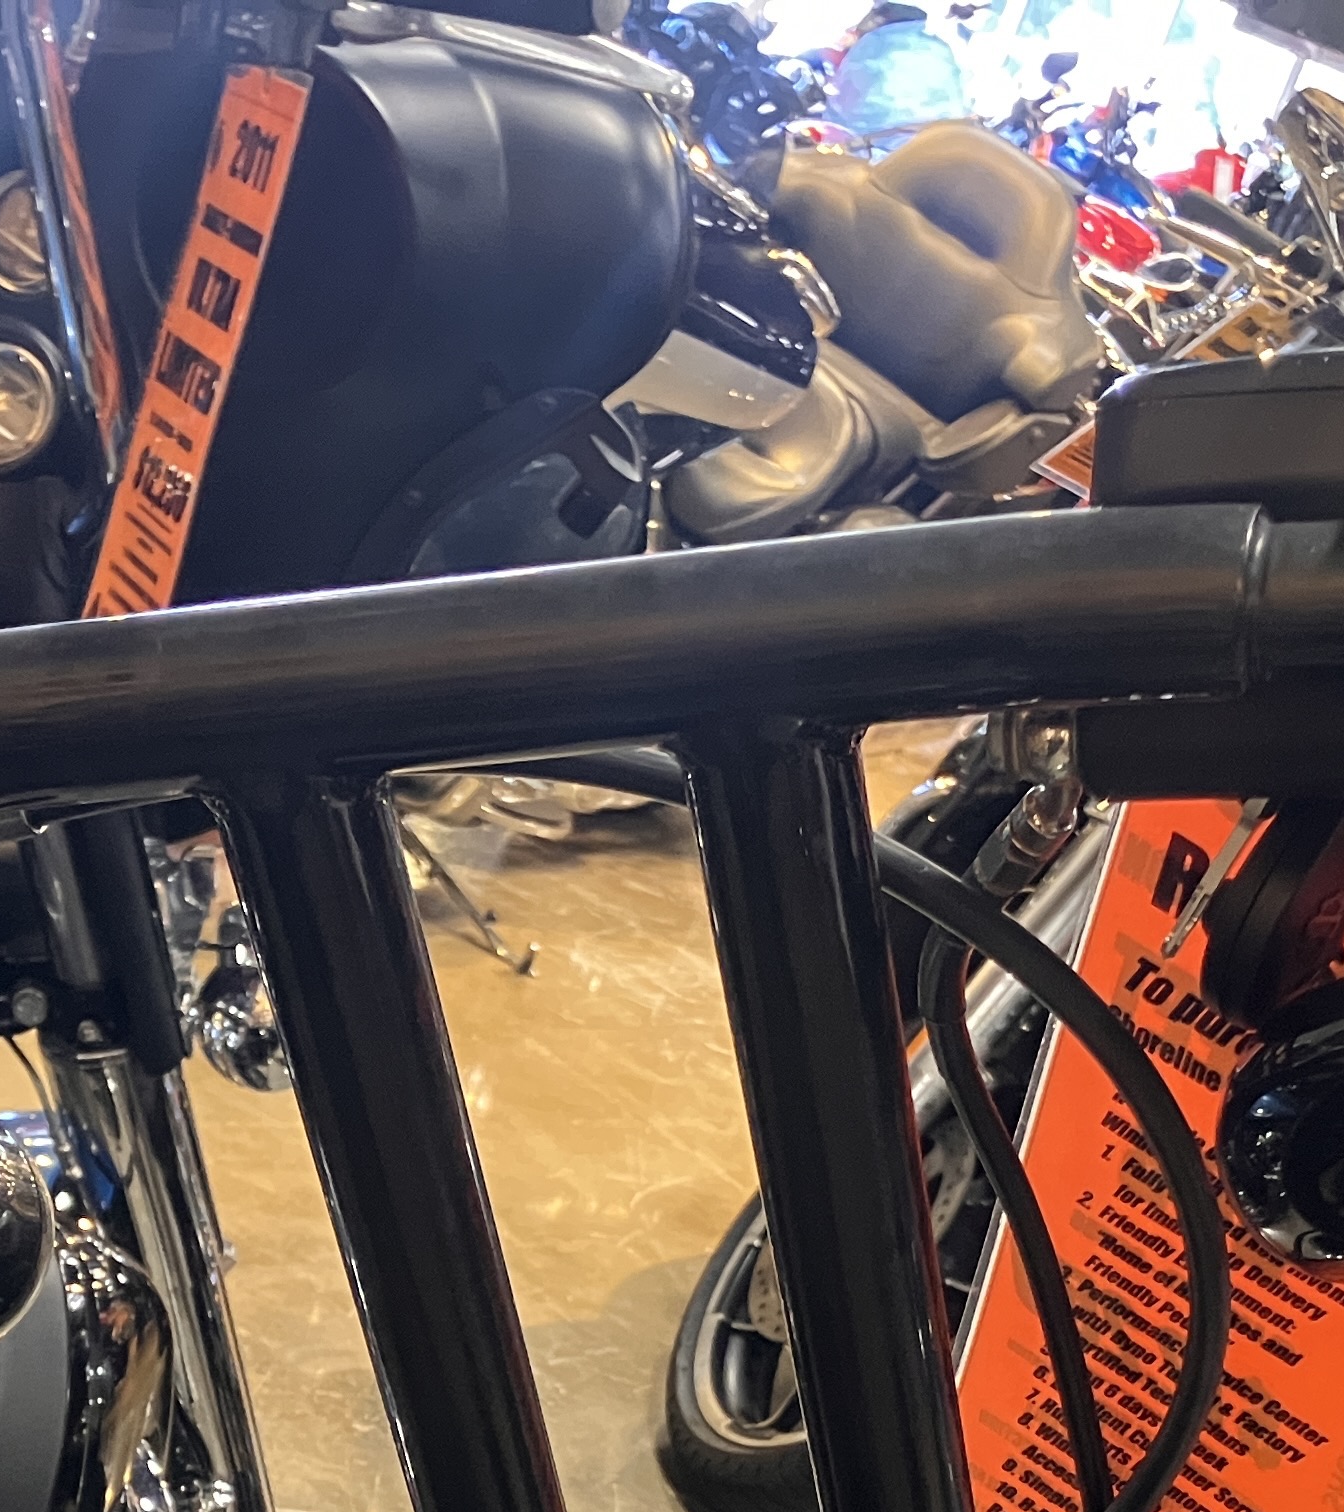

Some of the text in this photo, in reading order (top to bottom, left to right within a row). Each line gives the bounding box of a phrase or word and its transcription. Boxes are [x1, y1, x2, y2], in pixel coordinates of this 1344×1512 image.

[1125, 957, 1175, 1006] To
[1121, 1157, 1168, 1194] Fully
[1098, 1205, 1177, 1259] Friendly
[1114, 1184, 1146, 1208] for
[1244, 1265, 1327, 1322] Delivery
[1085, 1255, 1161, 1308] Friendly
[1153, 1271, 1178, 1288] of
[1261, 1338, 1304, 1367] and
[1033, 1365, 1050, 1384] 6.
[1073, 1305, 1307, 1464] with Dyno & Factory
[1077, 1279, 1186, 1357] Performanc
[1263, 1400, 1329, 1447] Center
[1017, 1411, 1034, 1430] 8.
[1103, 1383, 1122, 1398] 6
[1117, 1394, 1162, 1428] days
[1192, 1444, 1229, 1473] eek
[995, 1480, 1018, 1503] 10.
[1002, 1458, 1018, 1476] 9.
